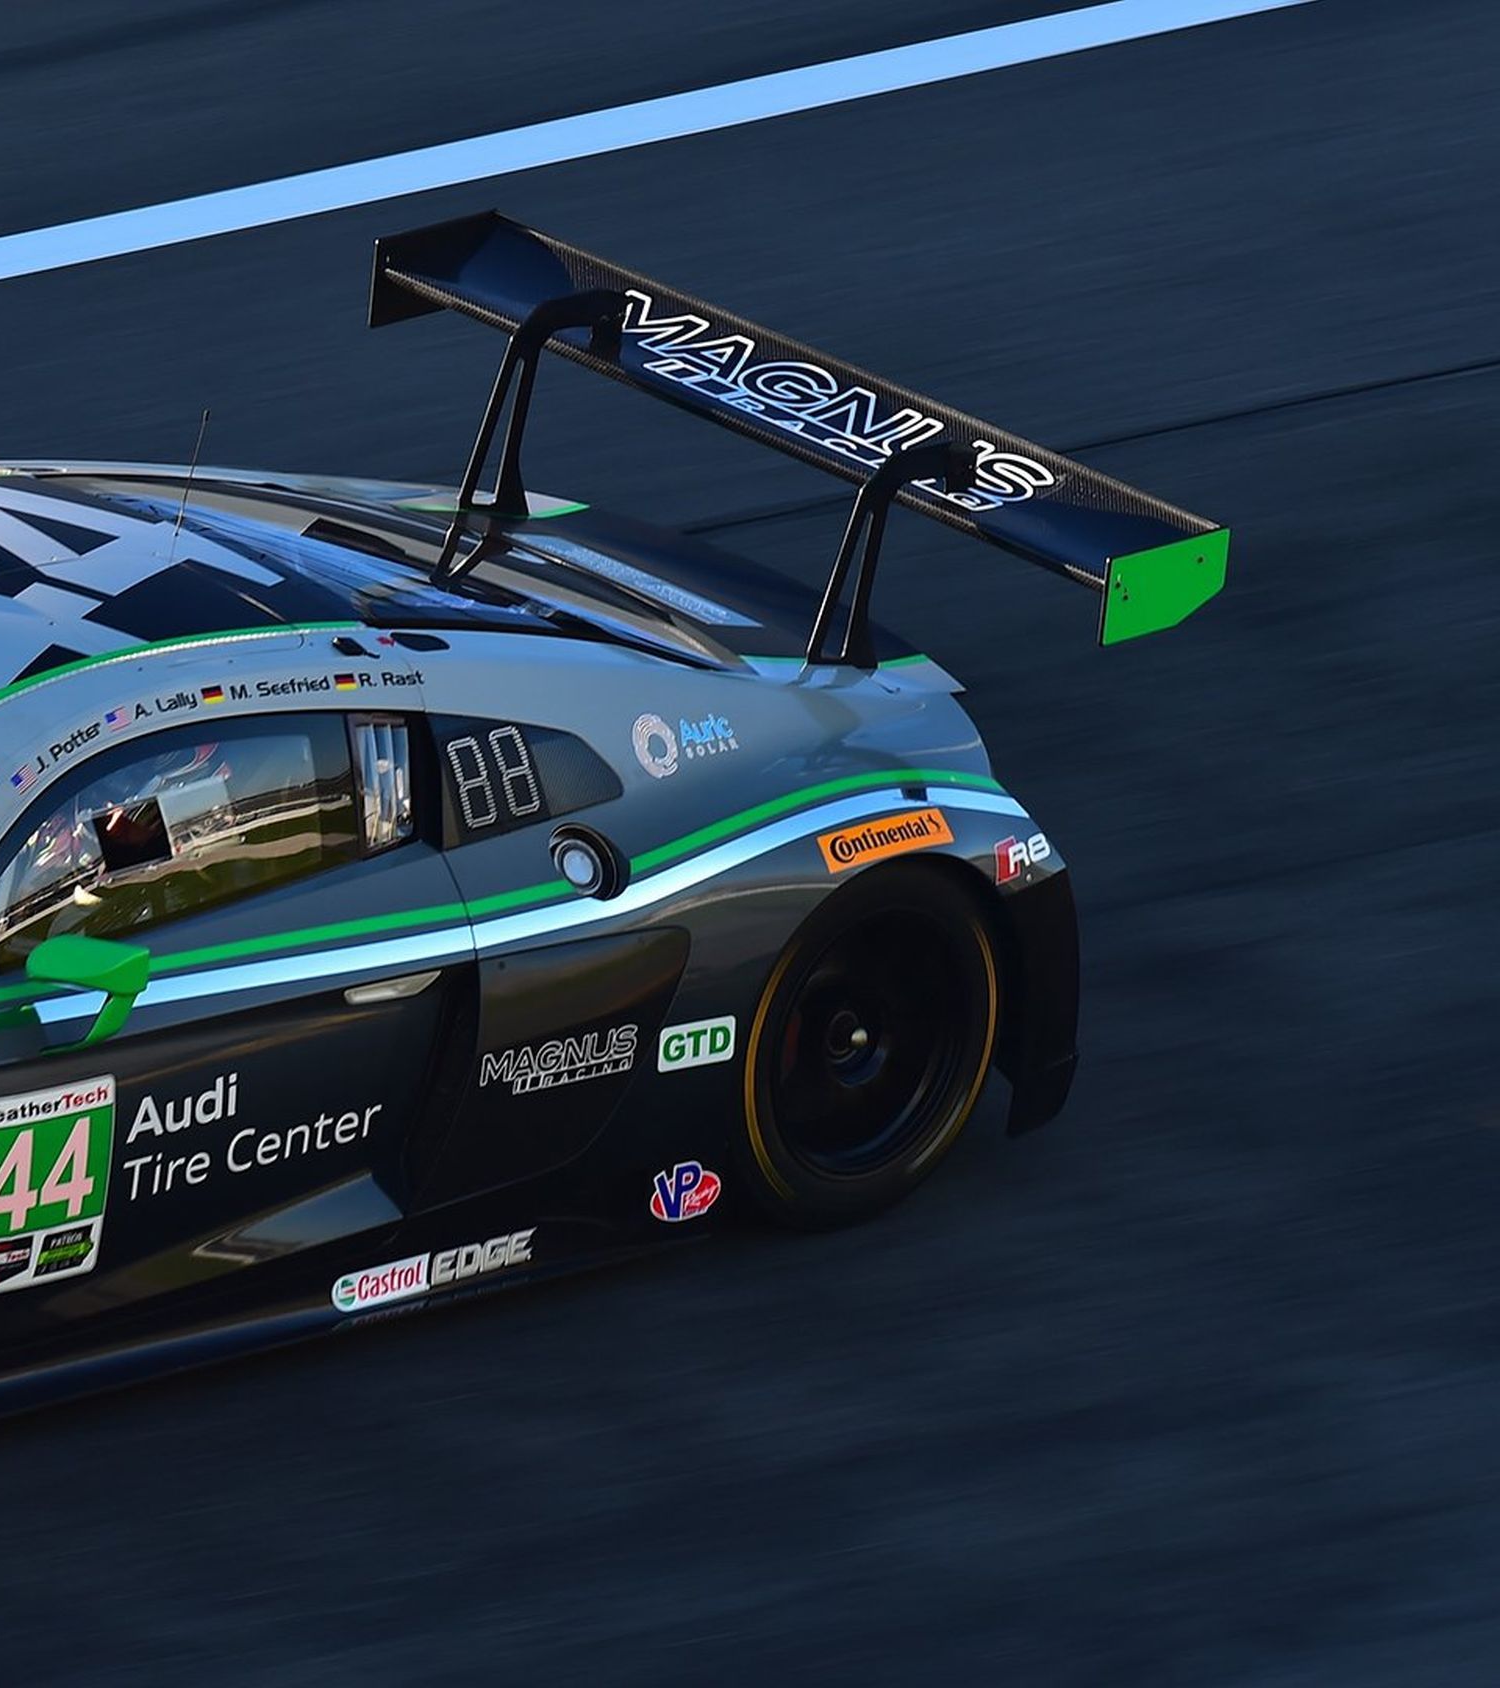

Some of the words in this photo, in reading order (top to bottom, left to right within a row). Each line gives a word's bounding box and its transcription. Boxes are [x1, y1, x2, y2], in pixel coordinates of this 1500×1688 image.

[229, 684, 252, 701] M.
[256, 676, 330, 697] Seefried
[358, 672, 377, 687] R.
[381, 670, 425, 687] Rast
[134, 703, 152, 720] A.
[155, 692, 198, 711] Lally
[49, 722, 102, 763] Potter
[680, 713, 734, 747] Auric
[685, 737, 739, 760] SOLAR
[829, 816, 931, 864] Continental
[1006, 832, 1051, 874] R8
[479, 1023, 639, 1088] MAGNUS
[662, 1024, 731, 1063] GTD
[535, 1054, 633, 1091] RACING
[126, 1072, 238, 1144] Audi
[122, 1153, 210, 1202] Tire
[226, 1103, 383, 1173] Center
[653, 1160, 703, 1221] VP
[357, 1259, 423, 1301] Castrol
[431, 1227, 538, 1285] EDGE
